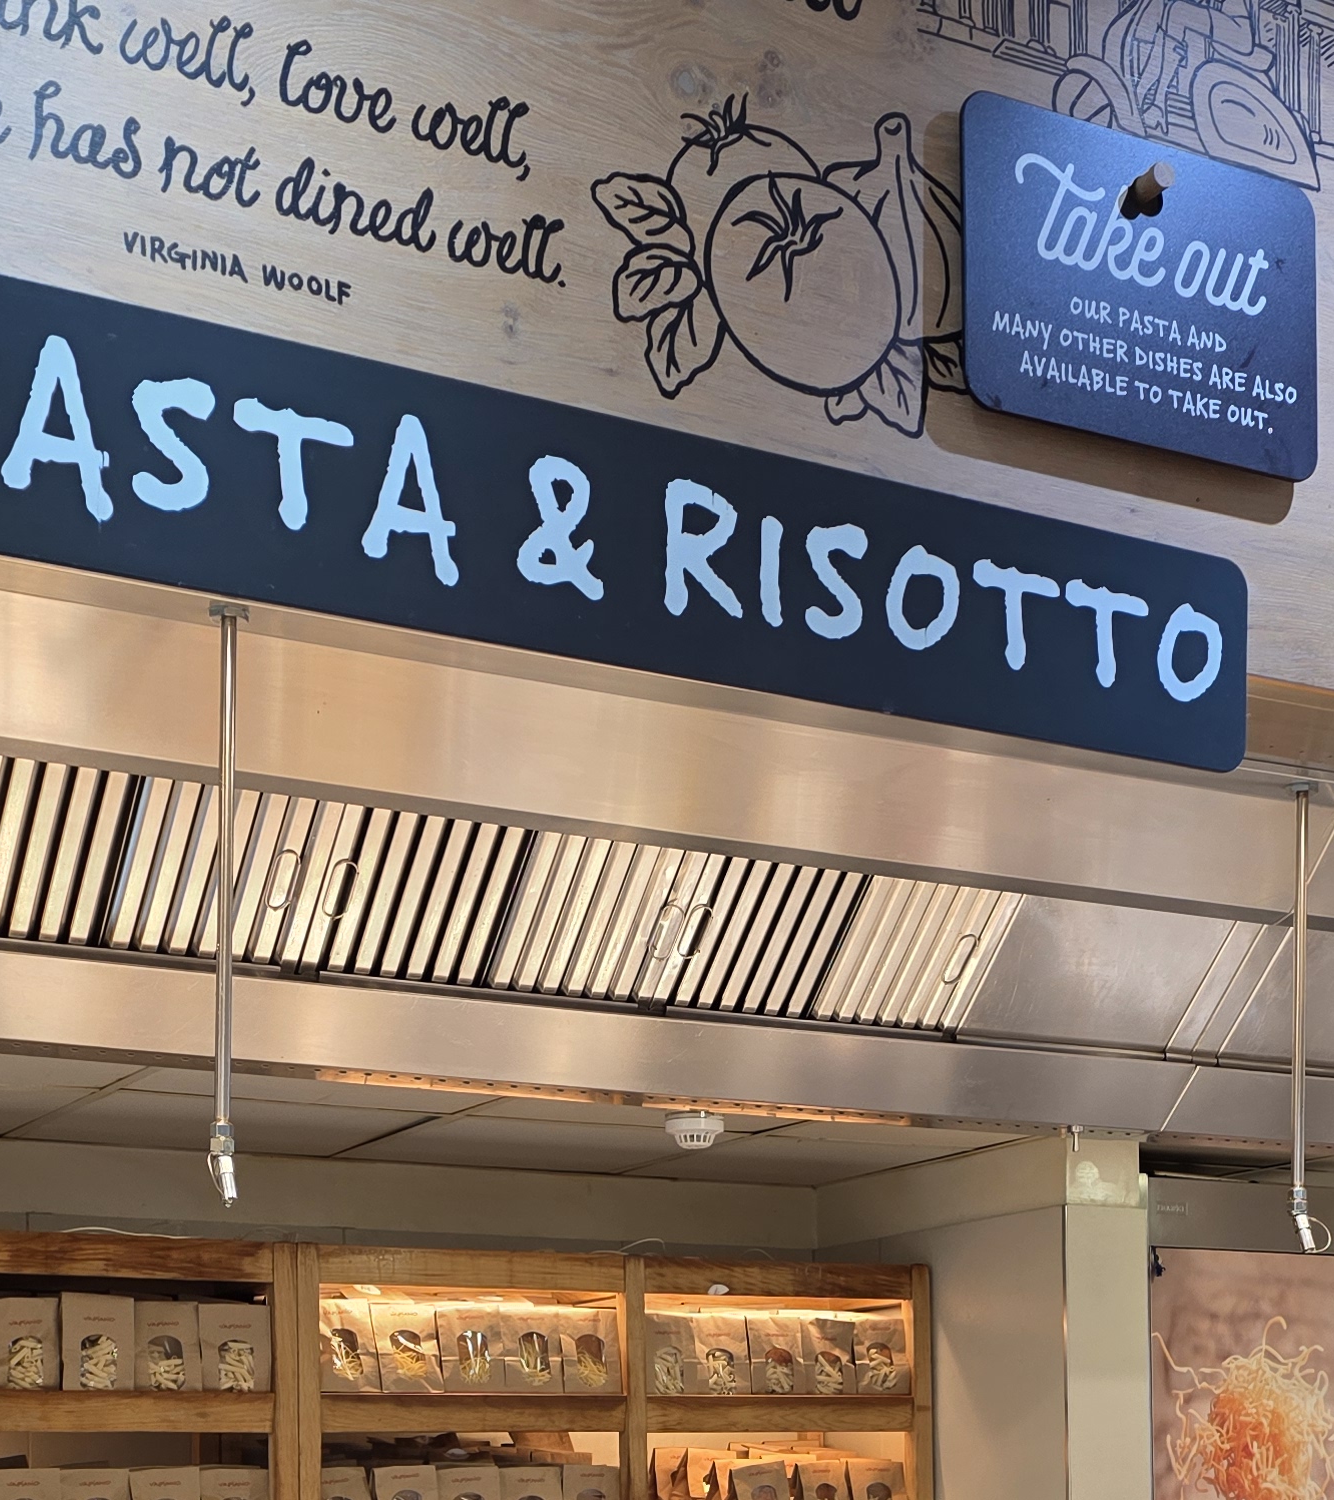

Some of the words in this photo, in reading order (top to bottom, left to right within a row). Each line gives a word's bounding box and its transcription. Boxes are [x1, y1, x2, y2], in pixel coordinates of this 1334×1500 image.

[119, 16, 257, 107] well,
[278, 39, 397, 134] love
[411, 96, 530, 181] well,
[27, 79, 143, 179] has
[158, 135, 261, 209] not
[275, 156, 437, 252] dined
[446, 213, 568, 288] well.
[1014, 152, 1167, 289] Take
[1174, 240, 1269, 317] out
[122, 230, 249, 284] VIRGINIA
[262, 263, 353, 305] WOOLF
[1070, 296, 1112, 323] OUR
[1118, 307, 1181, 345] PASTA
[1187, 325, 1226, 352] AND
[992, 310, 1052, 350] MANY
[1060, 328, 1128, 362] OTHER
[1135, 346, 1202, 381] DISHES
[1209, 364, 1247, 391] ARE
[1252, 375, 1297, 404] ALSO
[1020, 350, 1128, 395] AVAILABLE
[1134, 380, 1161, 403] TO
[1168, 389, 1221, 418] TAKE
[1227, 404, 1273, 434] OUT.
[516, 454, 603, 602] &
[663, 475, 1223, 705] RISOTTO
